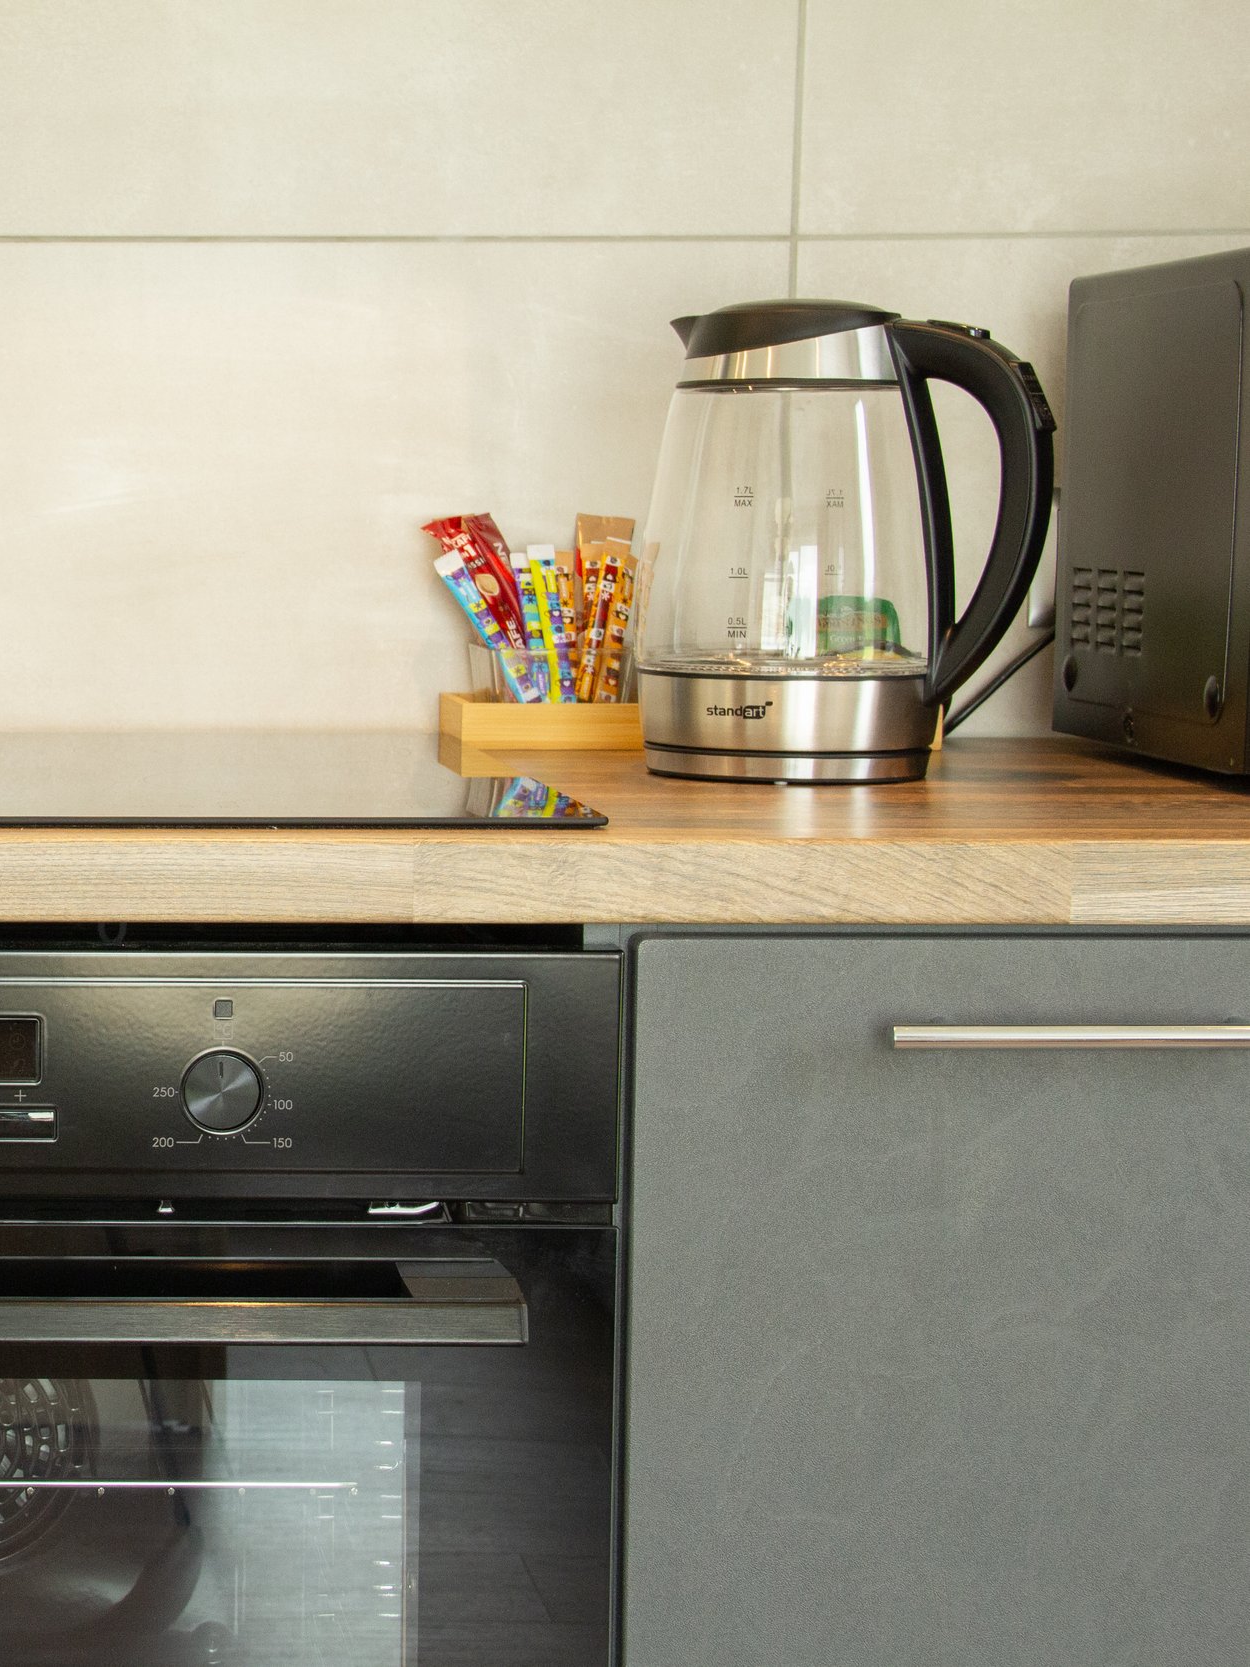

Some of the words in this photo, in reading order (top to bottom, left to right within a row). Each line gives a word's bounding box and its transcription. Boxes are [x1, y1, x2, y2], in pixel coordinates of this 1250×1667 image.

[736, 486, 754, 495] 1.7L
[734, 499, 752, 507] MAX
[730, 567, 748, 576] 1.0L
[728, 617, 747, 626] 0.5L
[727, 630, 747, 639] MIN
[706, 703, 769, 719] standart
[278, 1051, 294, 1062] 50
[152, 1087, 175, 1098] 250
[273, 1099, 293, 1110] 100
[152, 1137, 175, 1148] 200
[272, 1137, 293, 1149] 150
